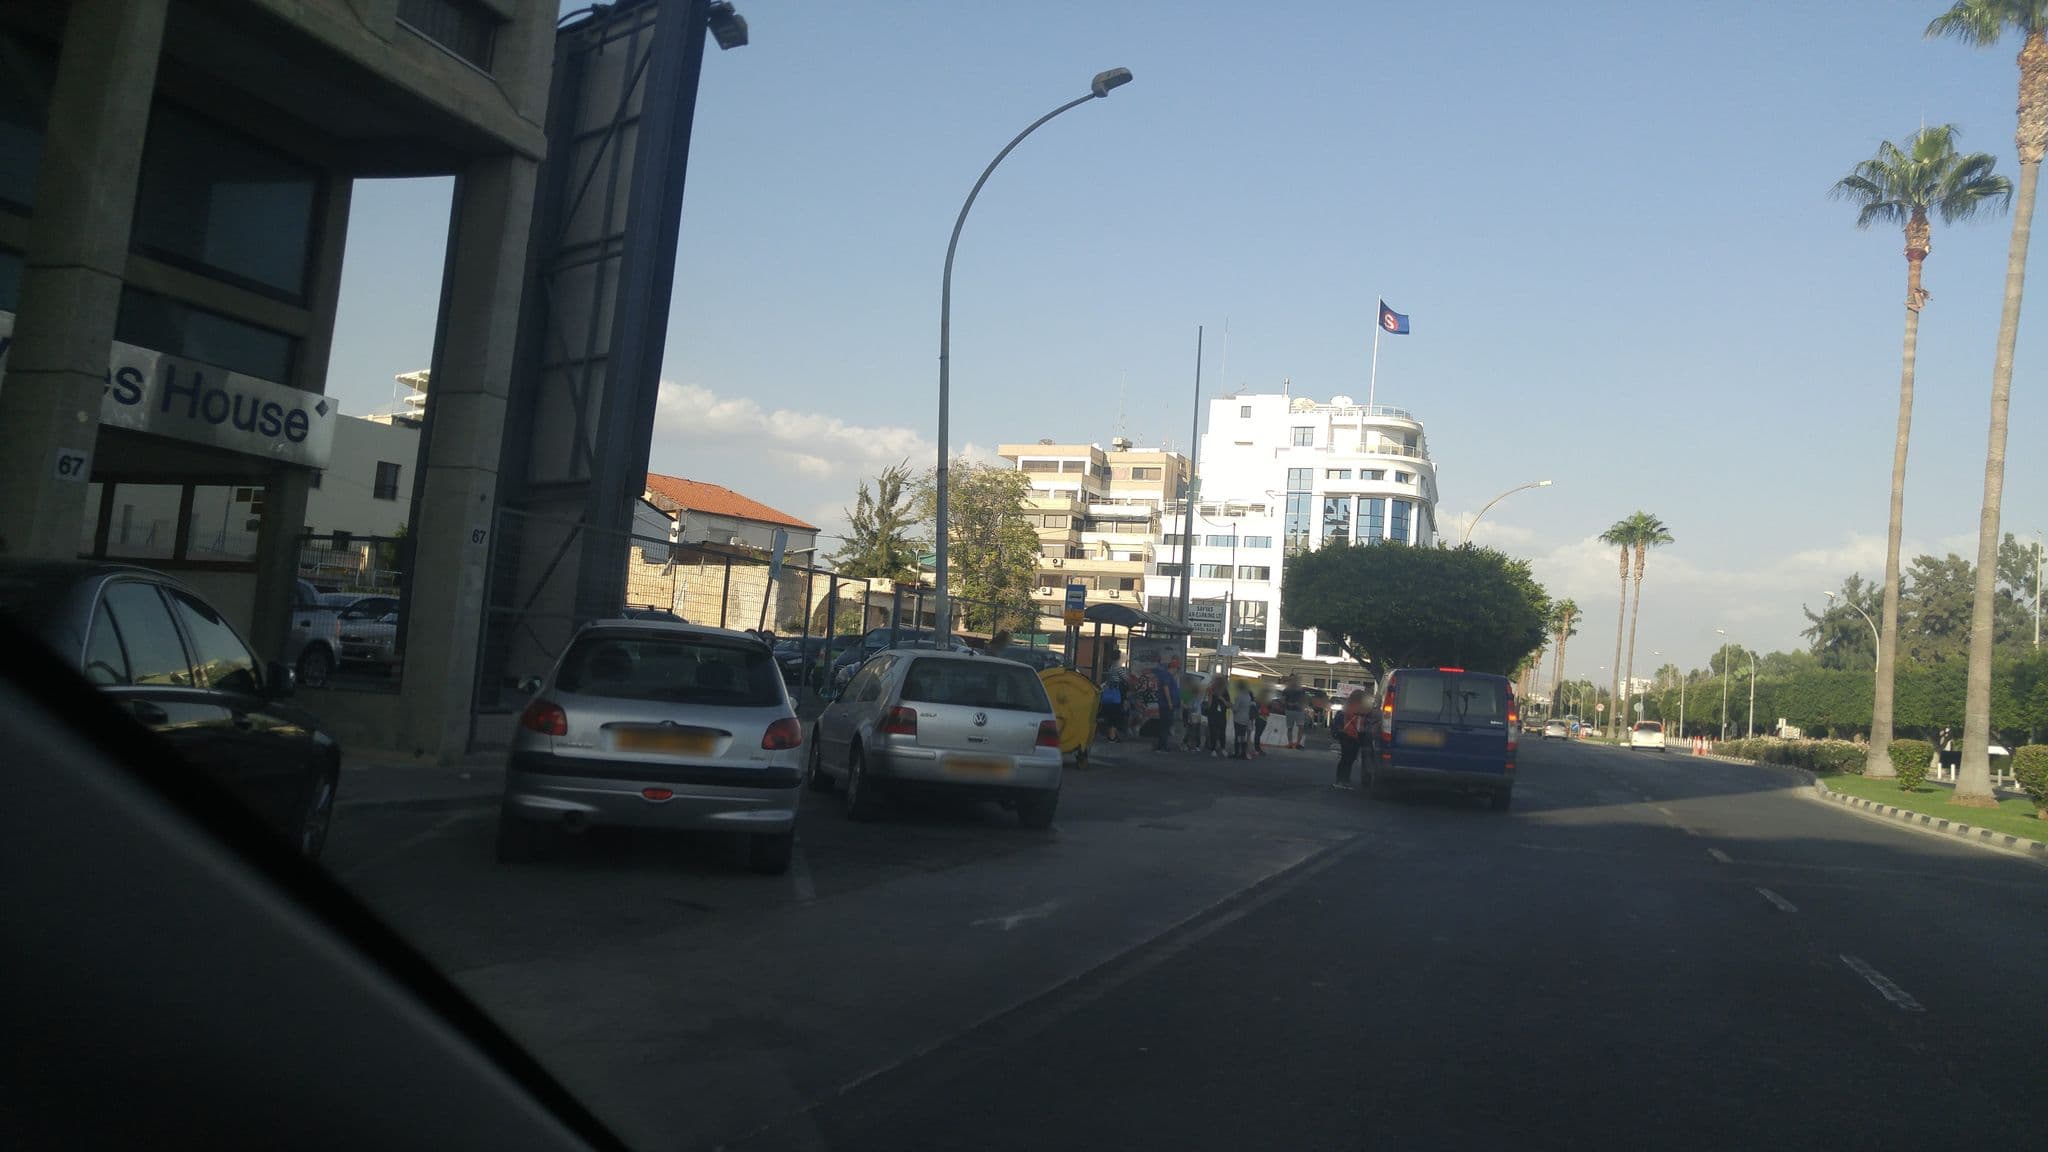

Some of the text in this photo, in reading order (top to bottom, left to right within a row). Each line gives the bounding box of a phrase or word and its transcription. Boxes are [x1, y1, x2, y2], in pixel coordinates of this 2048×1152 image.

[1384, 313, 1395, 330] S
[160, 364, 309, 443] House
[58, 455, 84, 476] 67
[472, 529, 487, 545] 67
